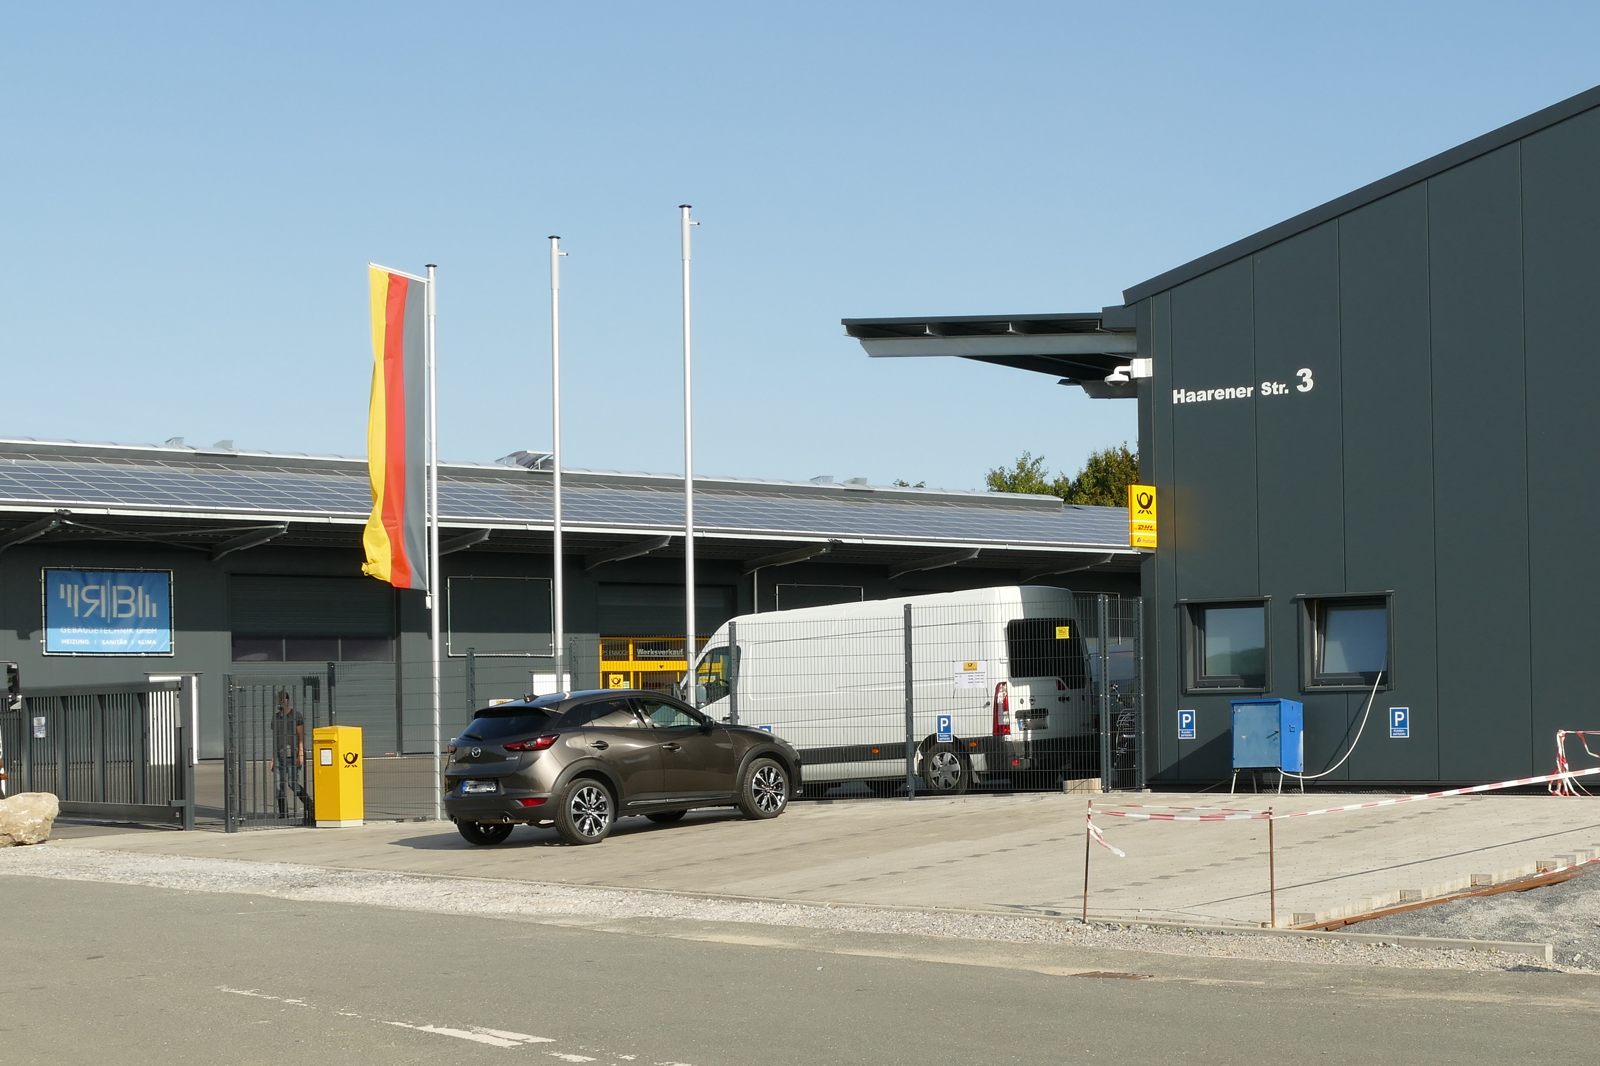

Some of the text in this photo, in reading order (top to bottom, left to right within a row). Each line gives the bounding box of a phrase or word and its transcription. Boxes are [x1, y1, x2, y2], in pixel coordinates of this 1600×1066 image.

[1172, 367, 1314, 404] Haarener Str. 3
[940, 717, 949, 732] P
[1182, 713, 1192, 728] P
[1394, 711, 1405, 727] P
